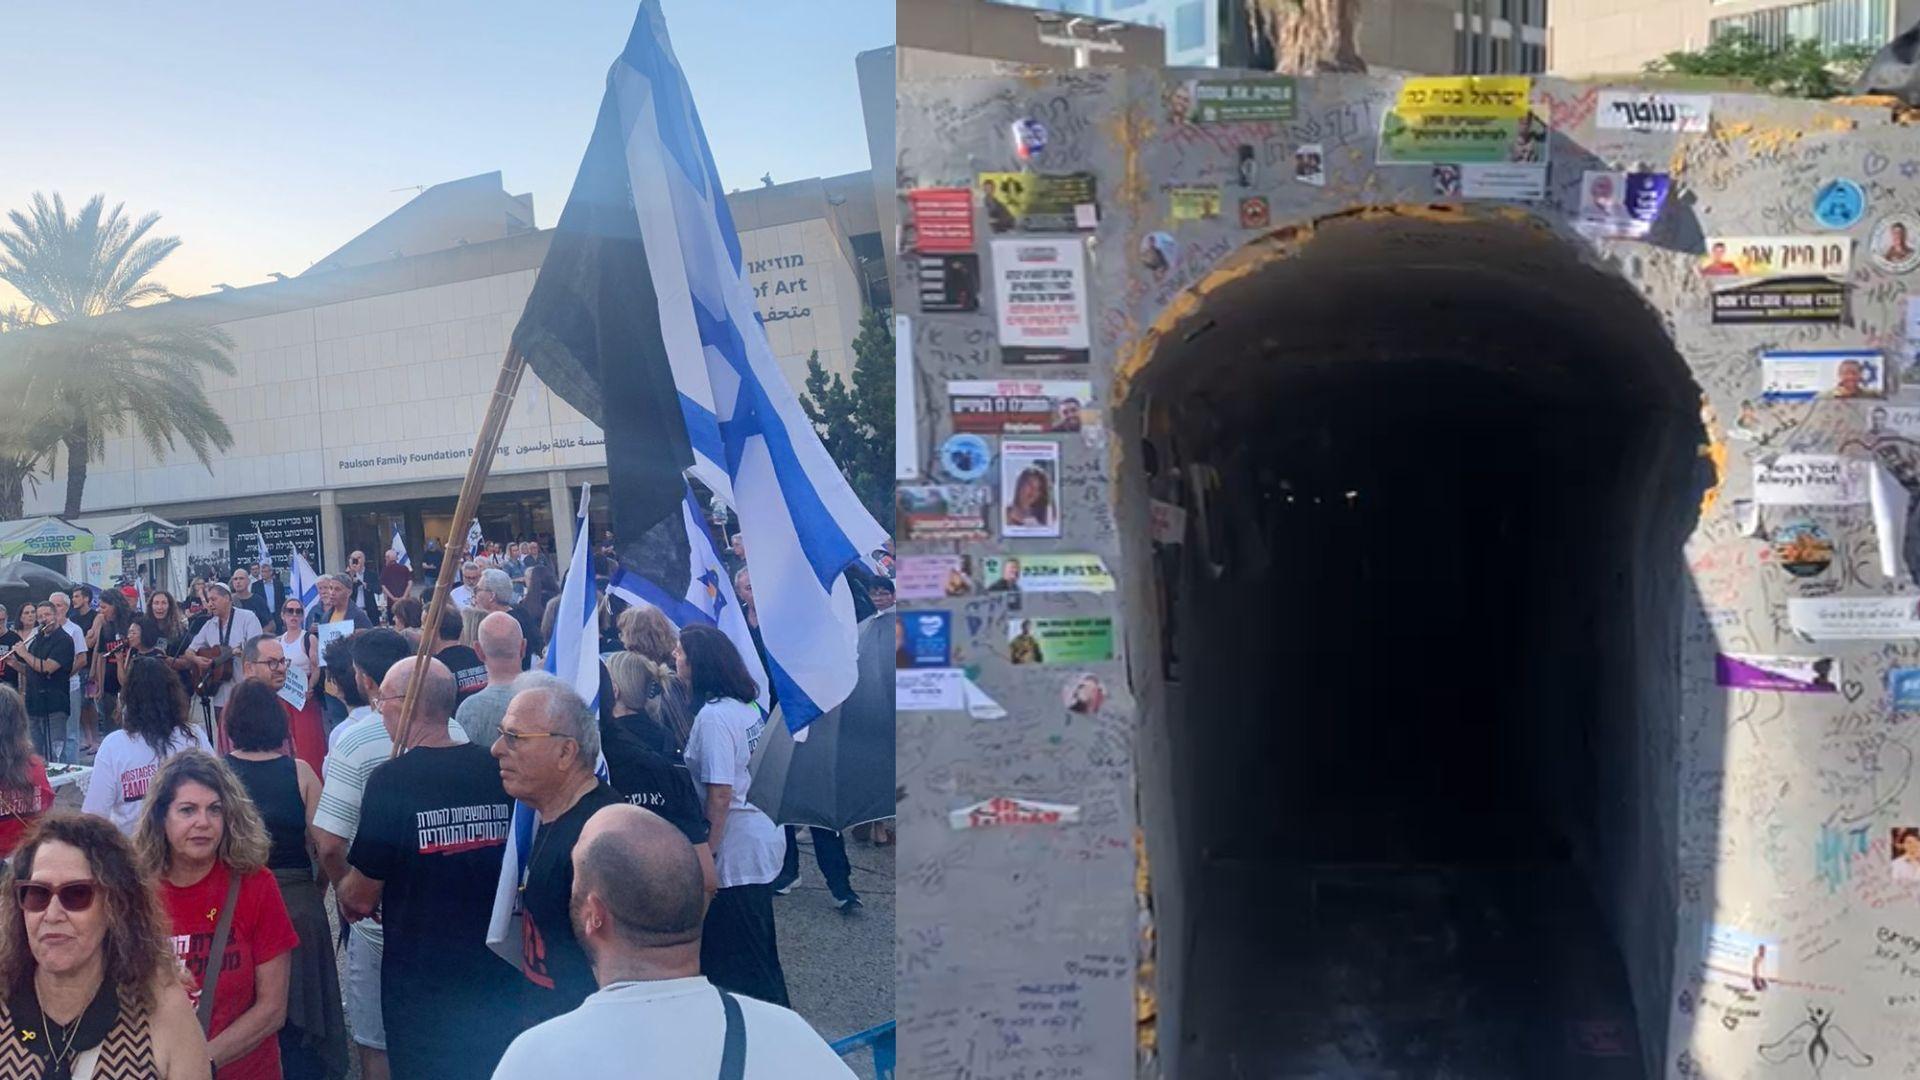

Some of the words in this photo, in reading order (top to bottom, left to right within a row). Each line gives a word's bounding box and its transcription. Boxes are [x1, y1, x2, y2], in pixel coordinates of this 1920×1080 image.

[747, 253, 804, 274] מוזיאו
[1779, 244, 1815, 269] חיוך
[1822, 243, 1843, 270] תן
[775, 278, 808, 296] Art
[1749, 294, 1782, 307] CLOSE
[339, 458, 374, 470] Paulson
[376, 454, 408, 466] Family
[410, 448, 466, 462] Foundation
[1757, 474, 1803, 487] Always
[302, 516, 314, 524] אנו
[650, 792, 665, 805] לא
[416, 808, 449, 828] להחזרת
[451, 805, 491, 823] המשפחות
